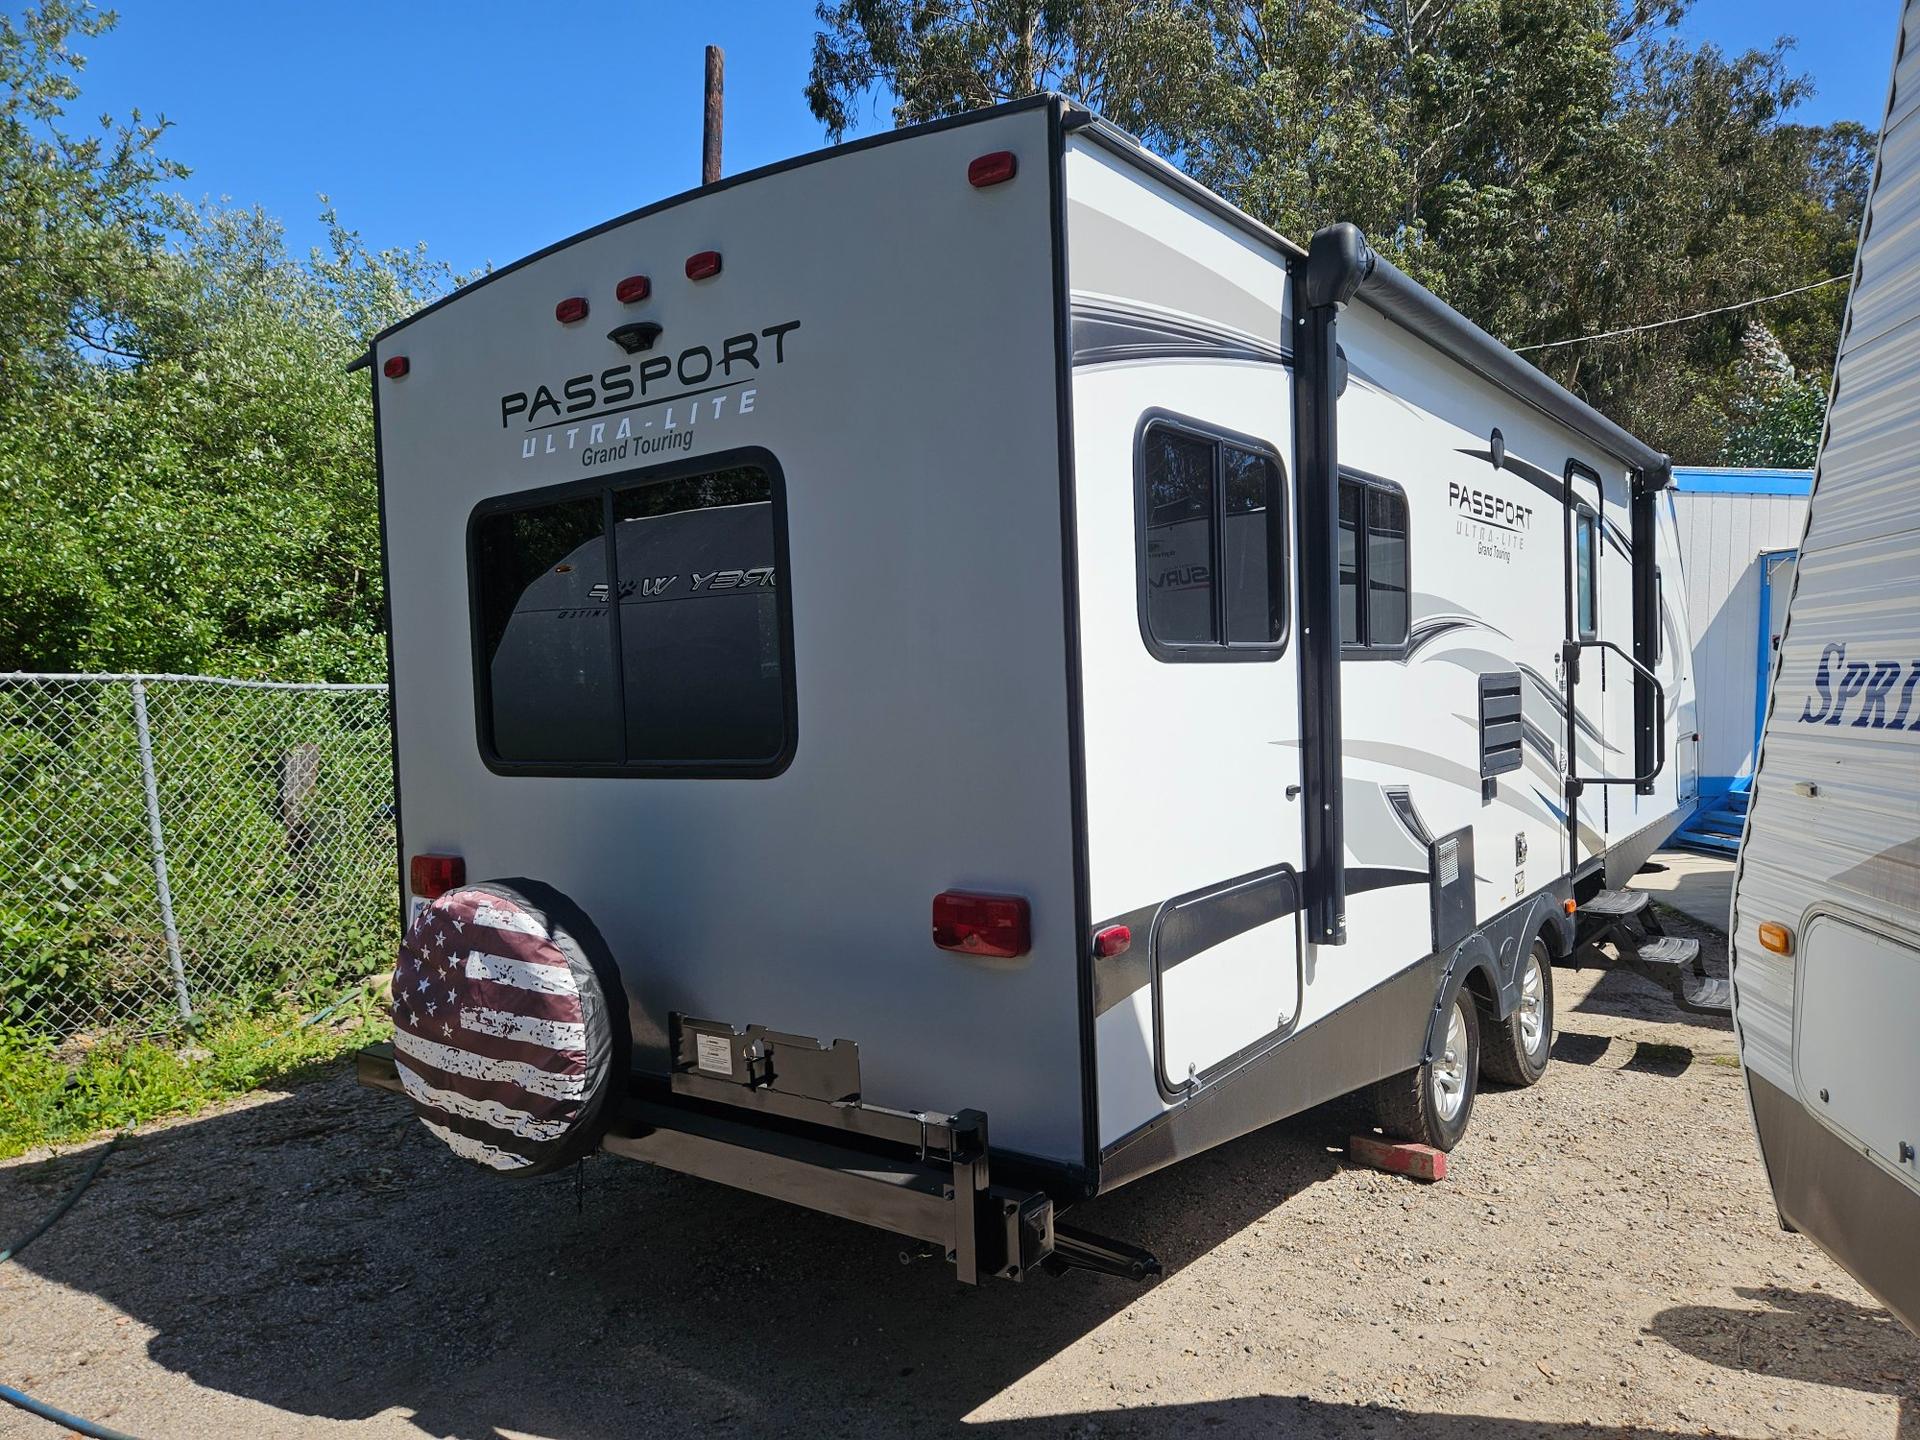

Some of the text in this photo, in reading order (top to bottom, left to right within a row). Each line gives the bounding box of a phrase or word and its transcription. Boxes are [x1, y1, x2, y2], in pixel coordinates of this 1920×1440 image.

[501, 319, 801, 429] PASSPORT
[521, 389, 758, 459] ULTRA-LITE
[582, 429, 694, 467] Grand Touring
[1449, 481, 1533, 530] PASSPORT
[1456, 520, 1524, 550] ULTRA-LITE
[1478, 541, 1511, 564] Grand Touring
[1798, 642, 1920, 732] SPRI
